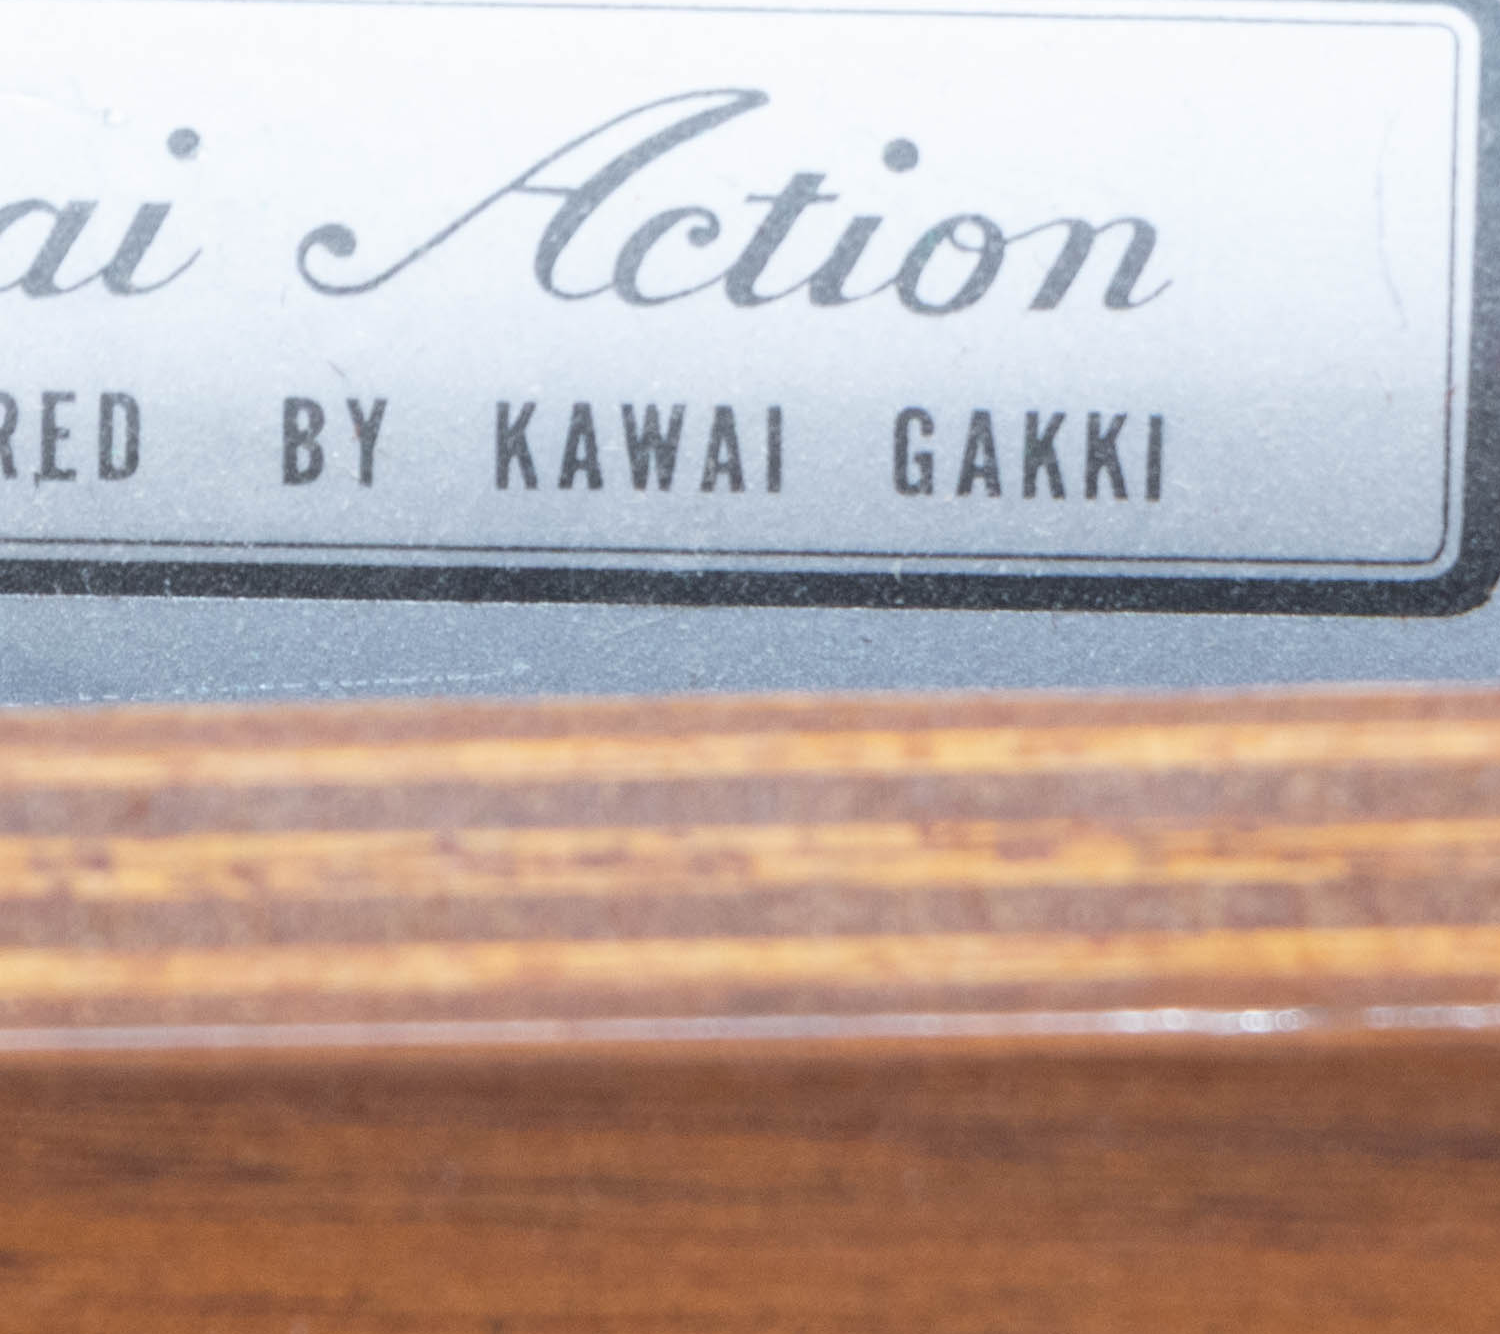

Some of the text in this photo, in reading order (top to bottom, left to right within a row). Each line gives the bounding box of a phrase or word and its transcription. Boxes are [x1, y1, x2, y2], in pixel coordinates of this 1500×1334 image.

[295, 87, 1173, 319] Action
[280, 394, 390, 491] BY
[493, 399, 786, 495] KAWAI
[890, 404, 1166, 504] GAKKI
